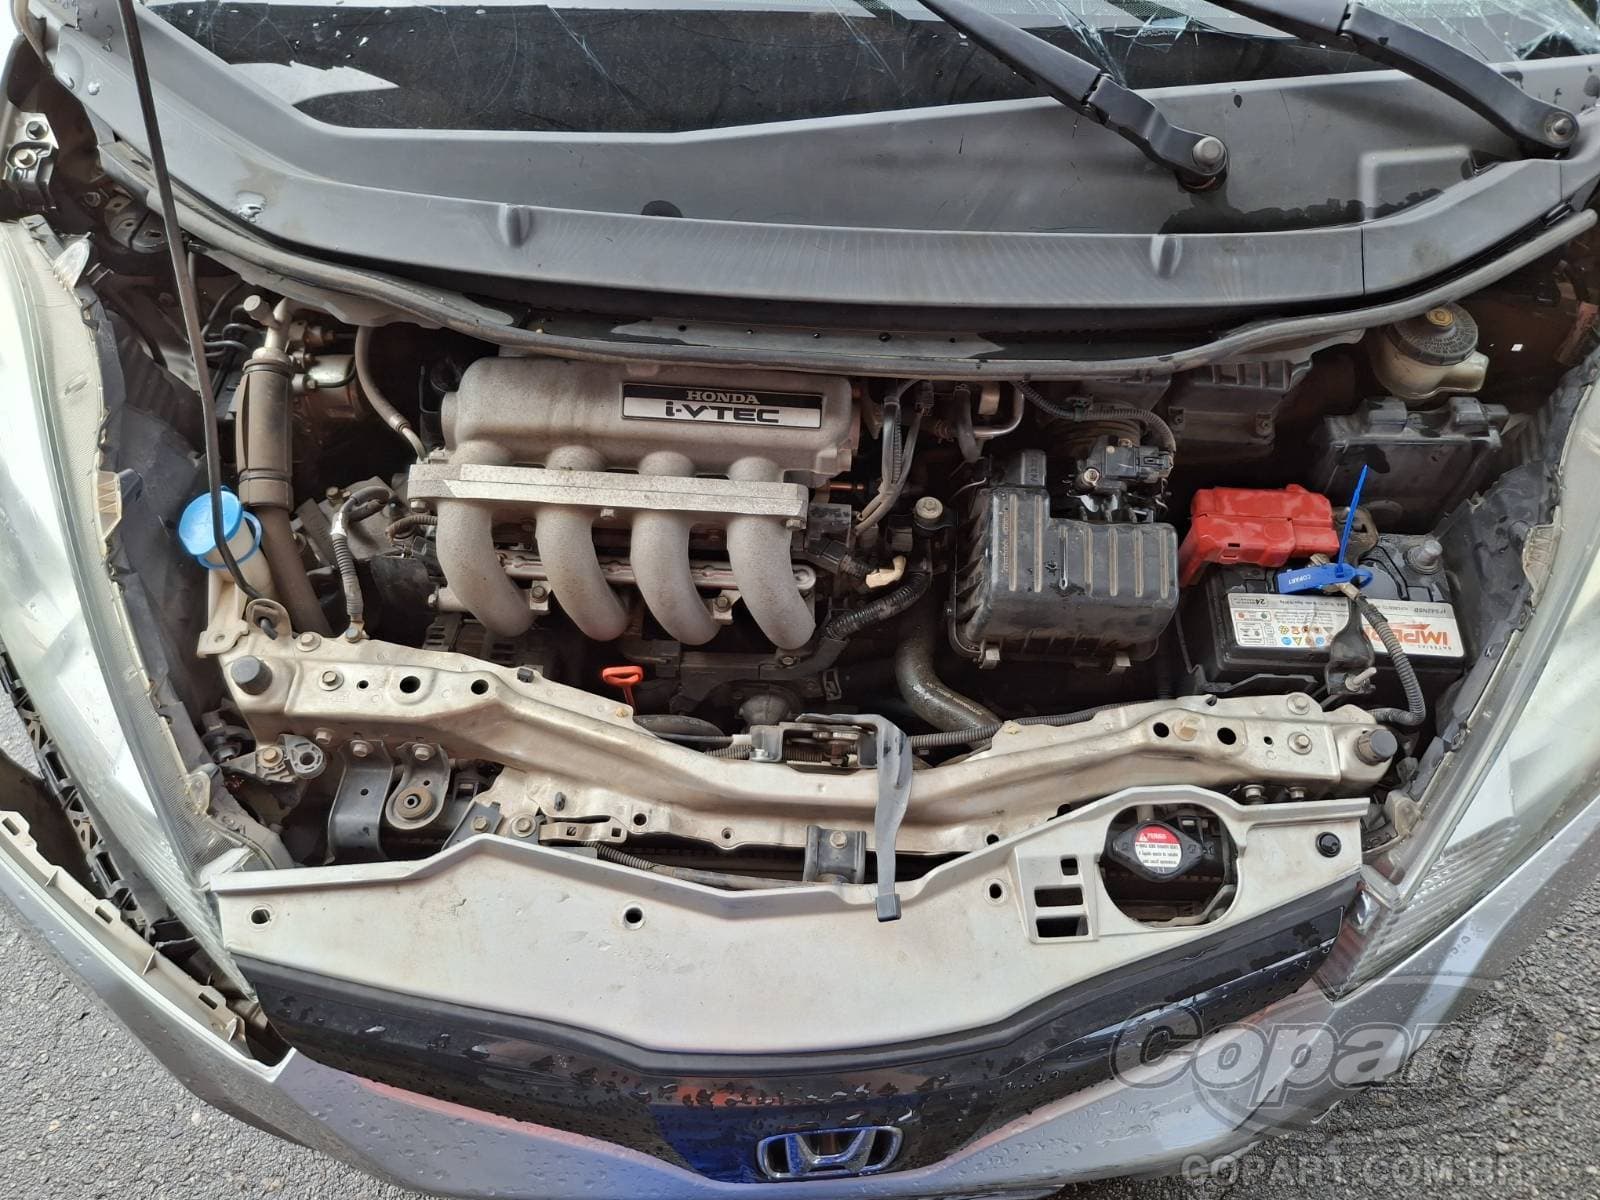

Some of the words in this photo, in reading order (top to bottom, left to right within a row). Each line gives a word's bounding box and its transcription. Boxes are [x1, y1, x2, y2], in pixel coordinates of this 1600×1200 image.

[685, 390, 760, 405] HONDA
[665, 401, 779, 424] i-VTEC
[1288, 573, 1311, 585] COPART
[1371, 628, 1448, 646] IMPE
